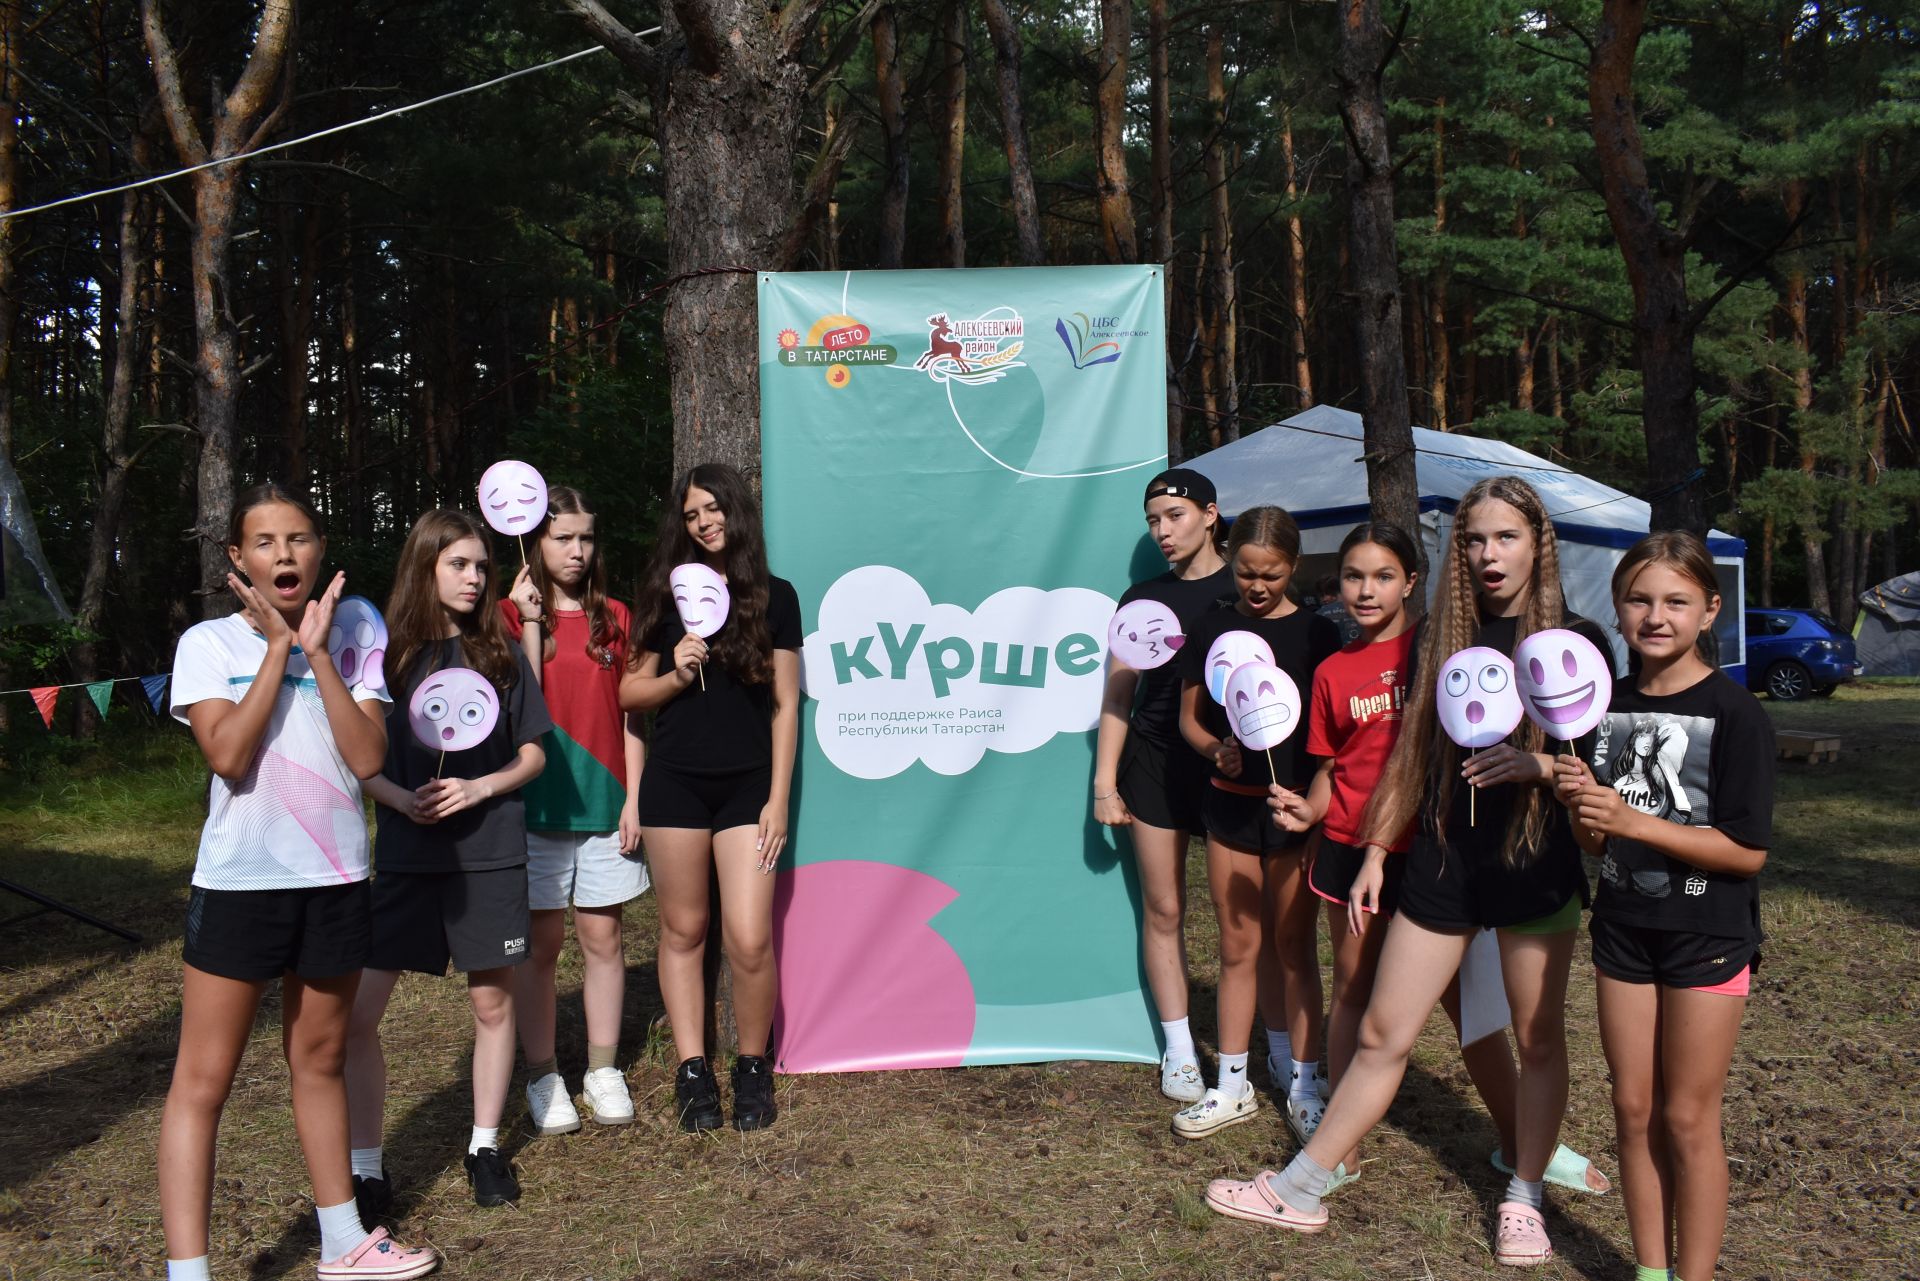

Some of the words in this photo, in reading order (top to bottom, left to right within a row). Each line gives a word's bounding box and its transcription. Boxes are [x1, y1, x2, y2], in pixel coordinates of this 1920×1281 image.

[954, 318, 1022, 337] АЛЕКСЕЕВСКИЙ
[1092, 317, 1120, 330] ЦБС
[831, 329, 863, 347] ЛЕТО
[1090, 330, 1150, 339] Алексеевское
[788, 351, 797, 362] В
[805, 349, 888, 362] ТАТАРСТАНЕ
[965, 339, 996, 357] район
[1349, 692, 1391, 722] Open
[838, 712, 866, 724] при
[871, 710, 955, 722] поддержке
[959, 707, 1003, 719] Раиса
[838, 724, 928, 738] Республики
[932, 723, 1005, 736] Татарстан
[504, 937, 525, 949] PUSH
